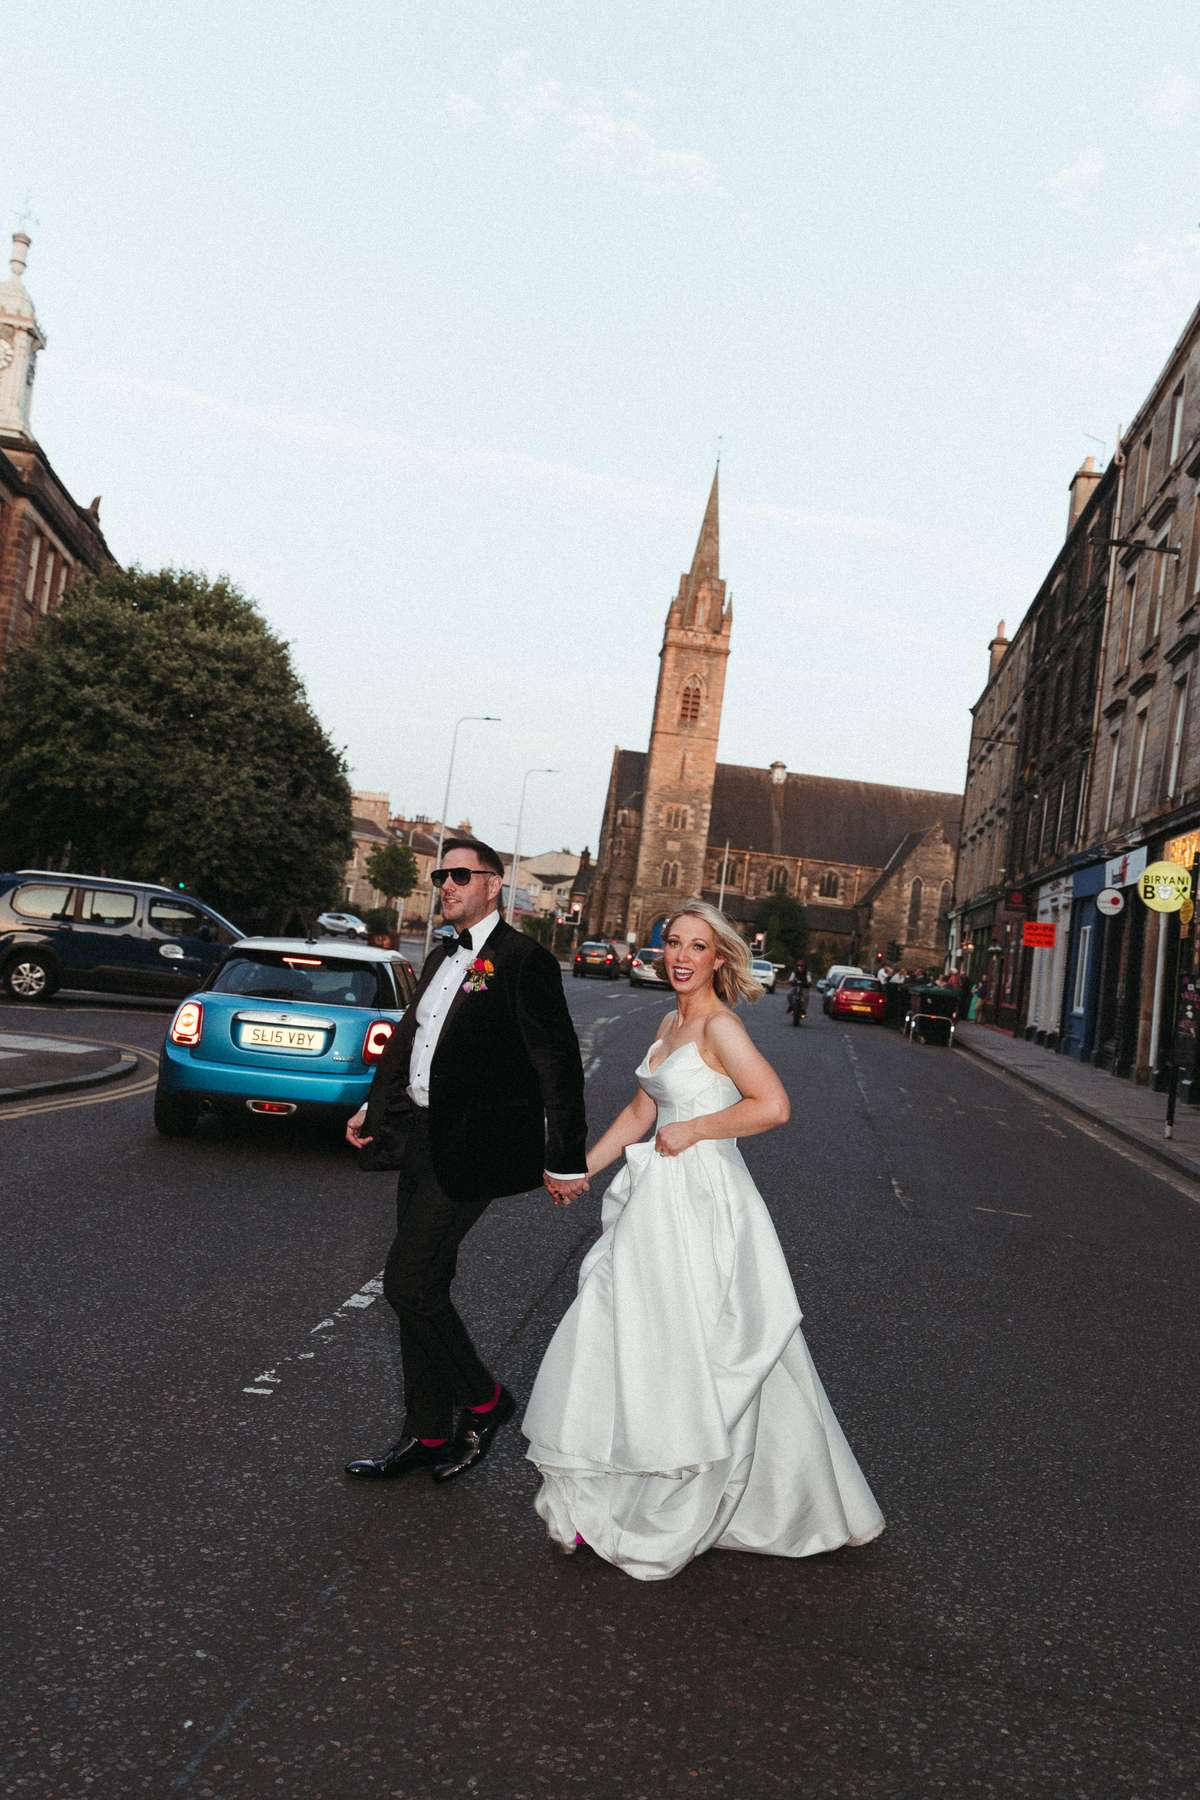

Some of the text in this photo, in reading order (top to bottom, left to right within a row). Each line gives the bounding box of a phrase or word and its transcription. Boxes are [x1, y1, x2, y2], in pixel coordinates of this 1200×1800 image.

[1143, 875, 1189, 885] BIRYANI
[252, 1029, 316, 1046] SL15 VBY
